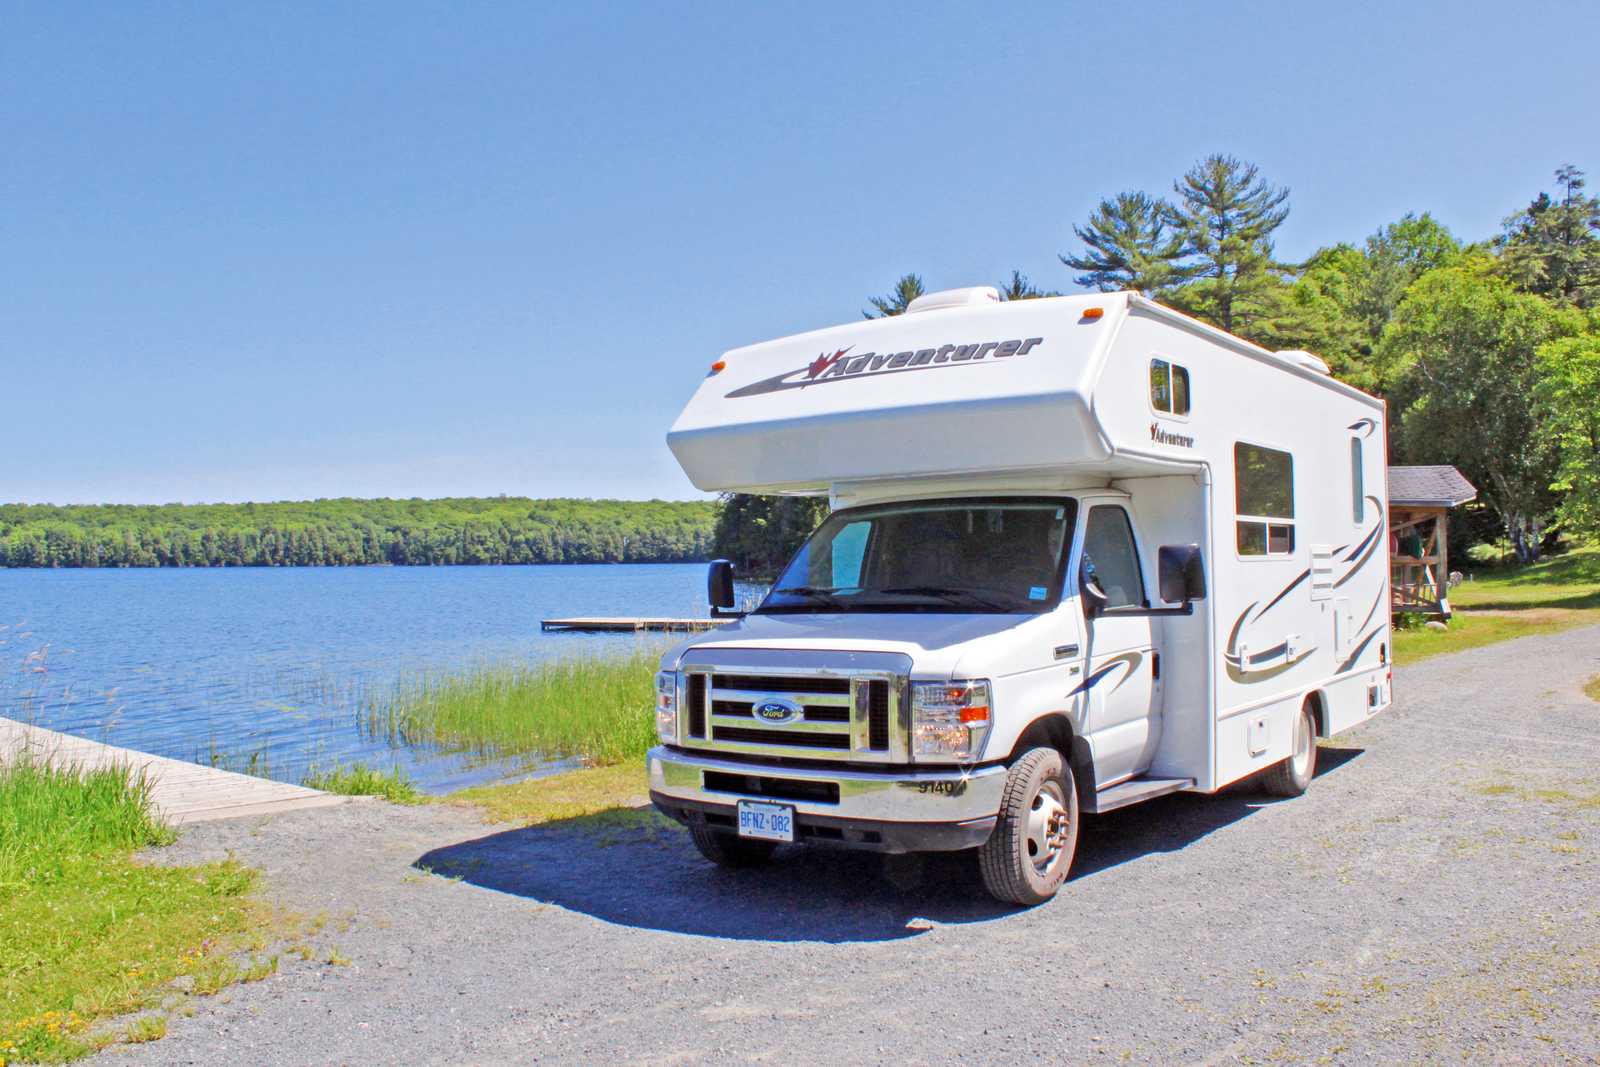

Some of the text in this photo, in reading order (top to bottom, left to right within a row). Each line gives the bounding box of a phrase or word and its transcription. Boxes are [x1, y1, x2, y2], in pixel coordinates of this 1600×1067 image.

[823, 337, 1043, 378] Adventurer
[1154, 427, 1194, 448] Adventurer
[762, 704, 785, 718] Ford
[919, 780, 954, 794] 9140
